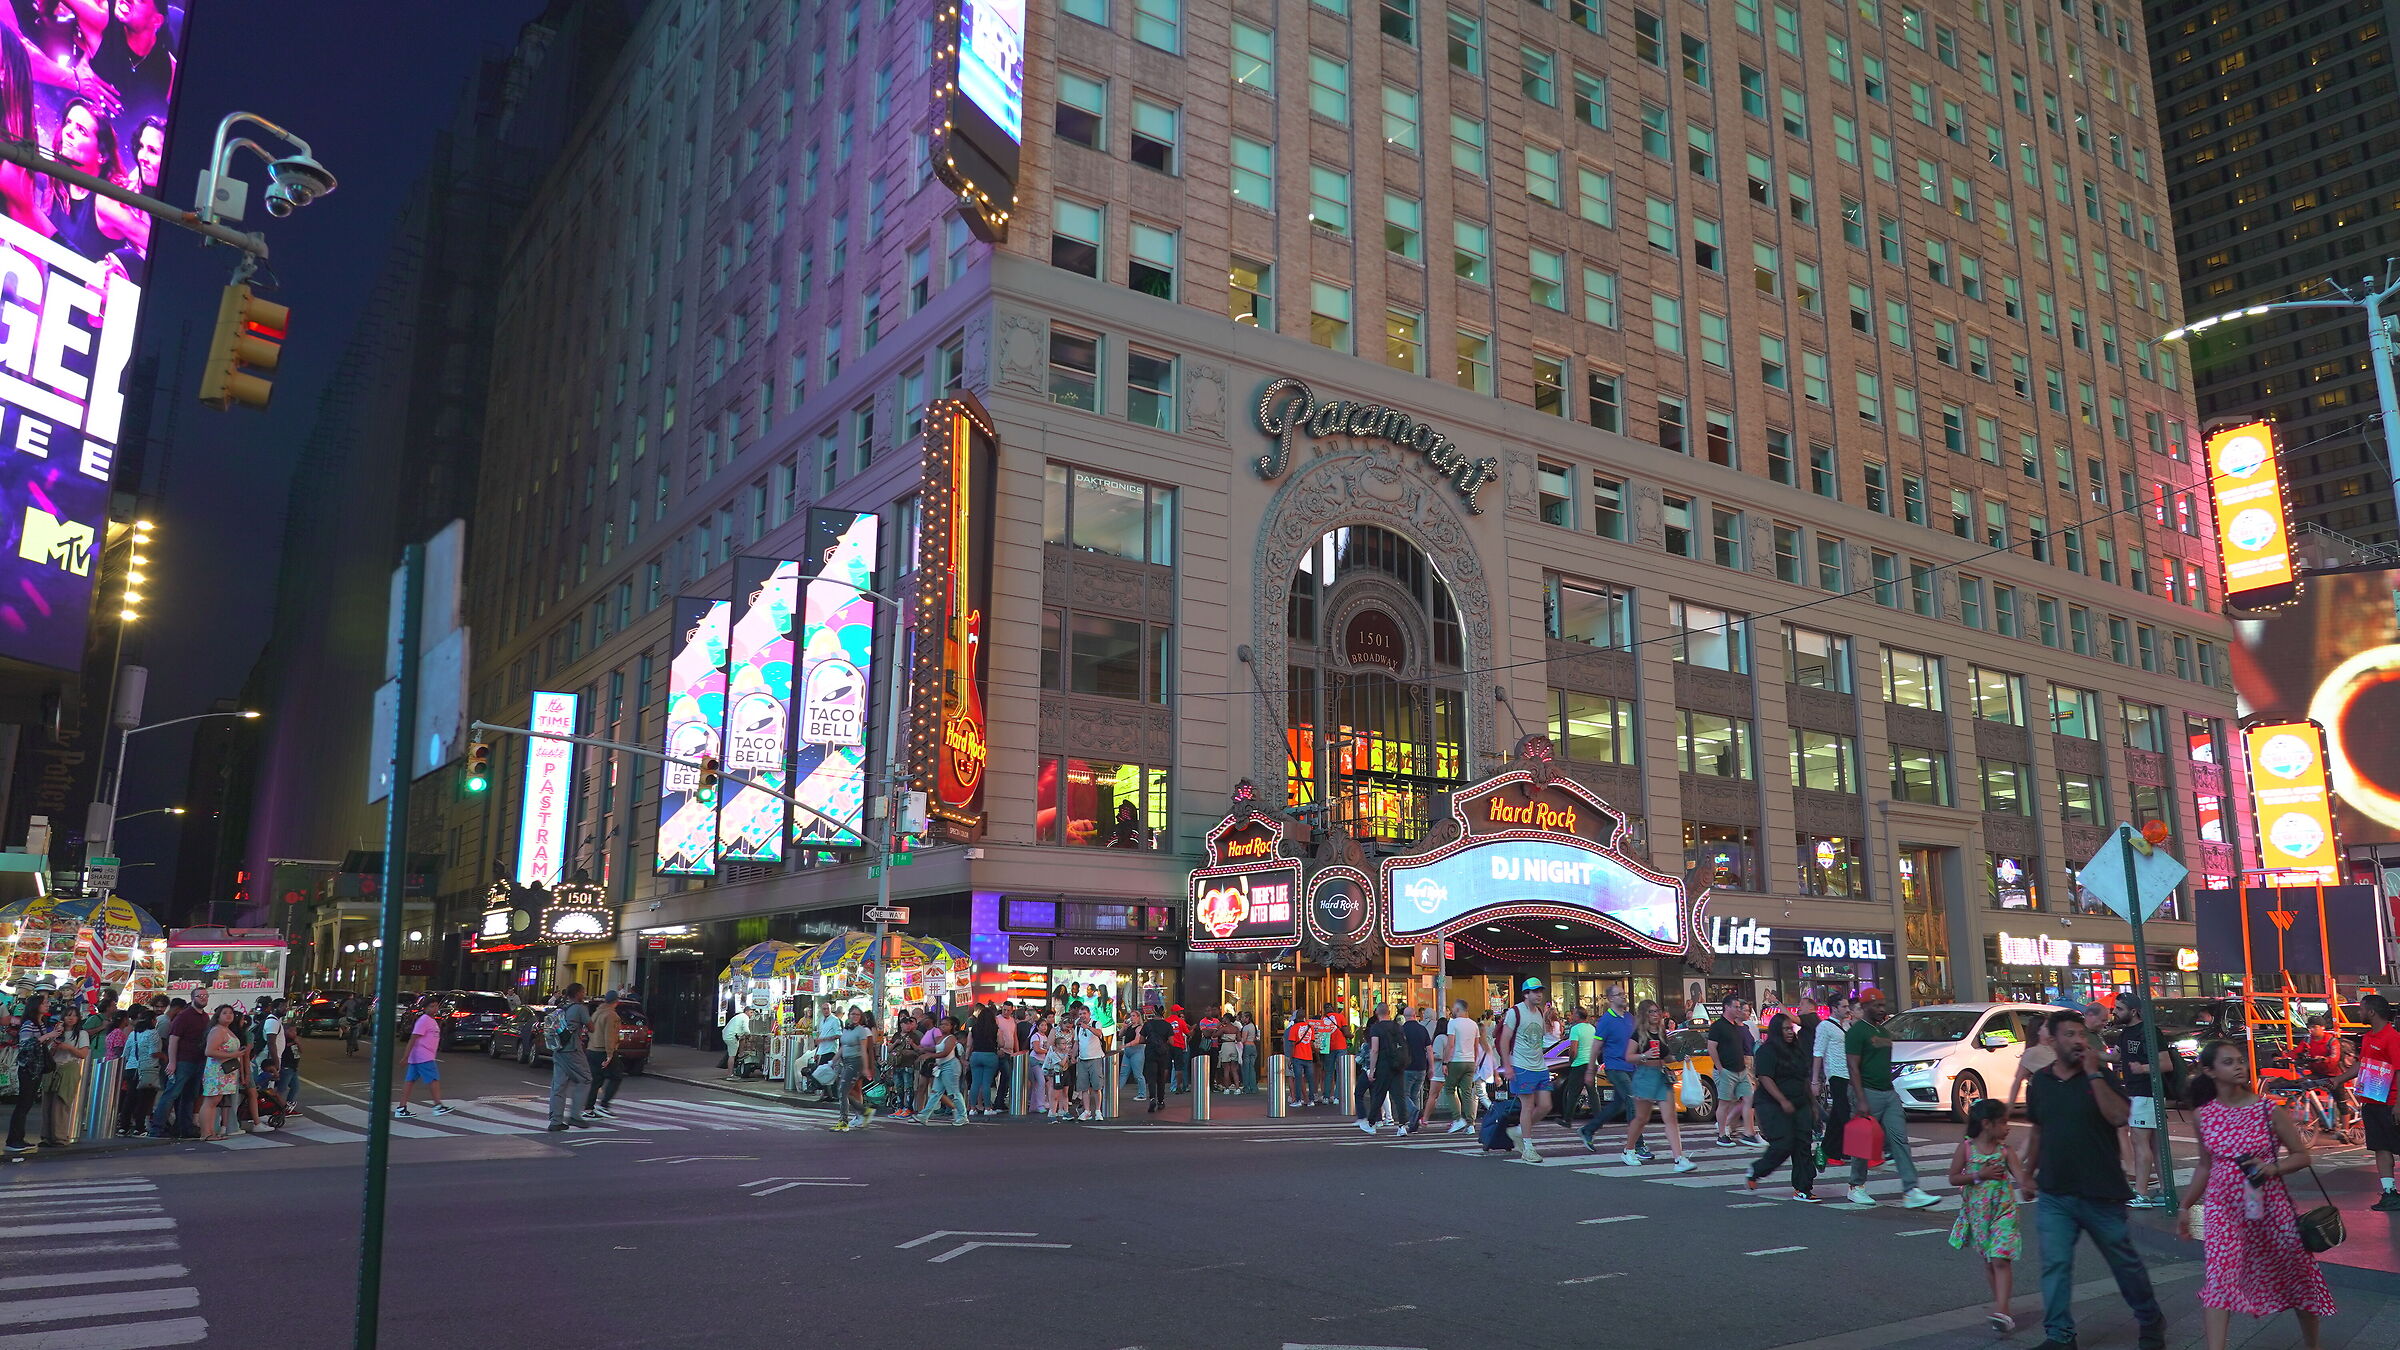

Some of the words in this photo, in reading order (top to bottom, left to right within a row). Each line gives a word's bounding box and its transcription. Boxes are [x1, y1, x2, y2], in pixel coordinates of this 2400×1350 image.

[1259, 377, 1499, 516] Paramount
[1076, 474, 1144, 494] DAKTRONICS
[19, 506, 95, 577] MTV
[1360, 631, 1389, 648] 1501
[1352, 652, 1398, 669] BROADWAY
[538, 715, 571, 727] TIME
[809, 707, 855, 722] TACO
[811, 722, 852, 737] BELL
[735, 736, 776, 750] TACO
[944, 720, 969, 754] Hard
[968, 732, 987, 768] Rock
[736, 751, 773, 763] BELL
[673, 763, 699, 773] TAC
[673, 774, 699, 785] BEL
[530, 762, 556, 881] PASTRAM
[1490, 797, 1534, 824] Hard
[1536, 802, 1577, 834] Rock
[1228, 838, 1254, 857] Hard
[1254, 837, 1273, 858] Roc
[1491, 855, 1520, 880] DJ
[1523, 858, 1594, 885] NIGHT
[568, 893, 592, 904] 1501
[1276, 883, 1289, 903] LIFE
[1320, 900, 1339, 909] Hard
[1340, 900, 1360, 911] Rock
[1711, 915, 1771, 955] Lids
[1073, 946, 1096, 956] ROCK
[1097, 947, 1120, 957] SHOP
[1803, 936, 1845, 958] TACO
[1849, 938, 1887, 960] BELL
[171, 981, 201, 990] SOFT
[212, 981, 229, 989] ICE
[240, 981, 275, 989] CREAM
